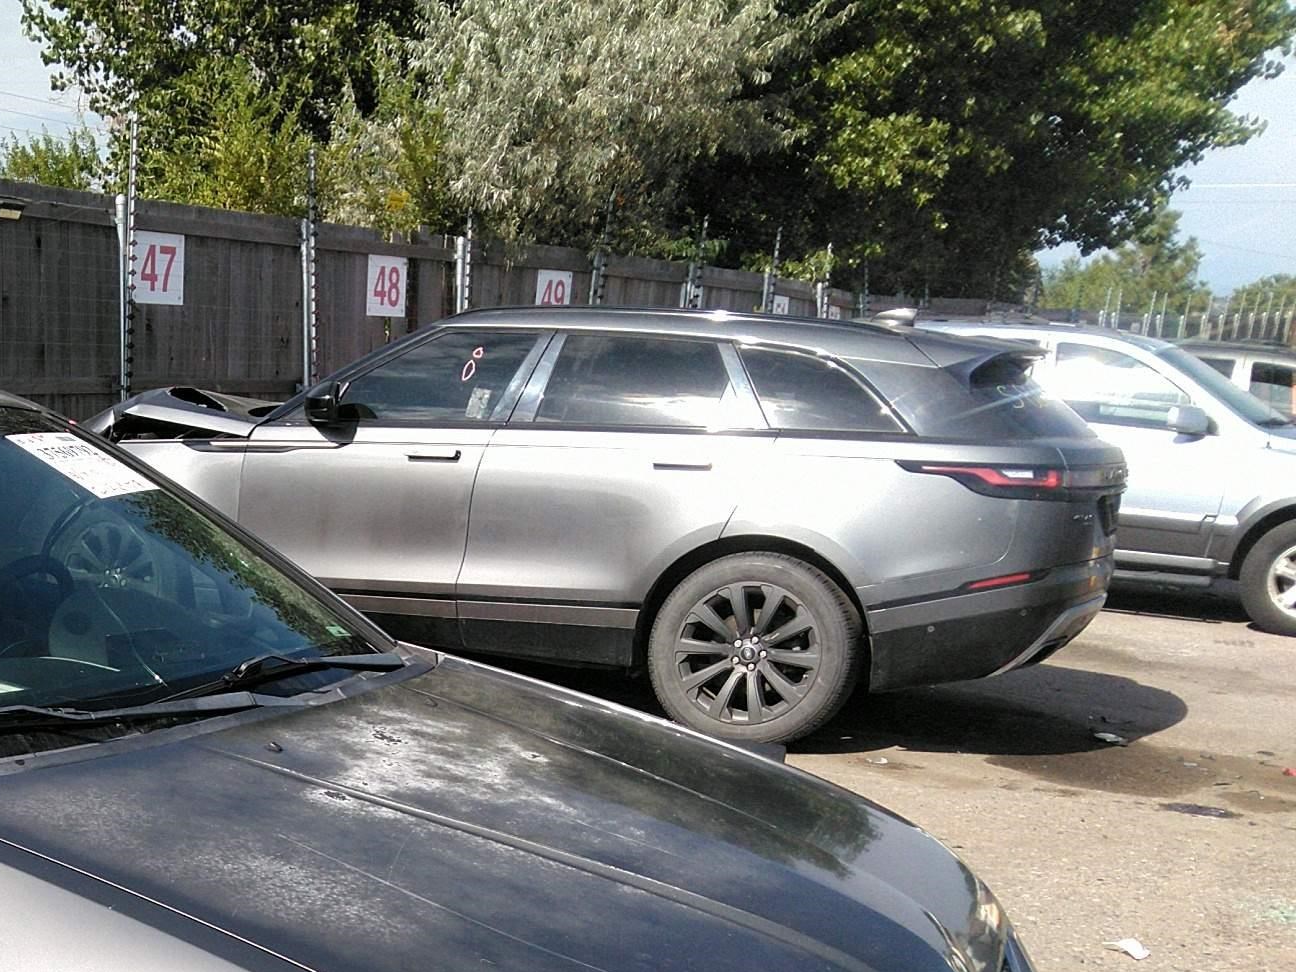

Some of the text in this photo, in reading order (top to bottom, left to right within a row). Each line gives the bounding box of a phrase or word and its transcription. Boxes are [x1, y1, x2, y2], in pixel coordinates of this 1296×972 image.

[141, 244, 177, 292] 47
[373, 266, 401, 307] 48
[541, 279, 565, 305] 49
